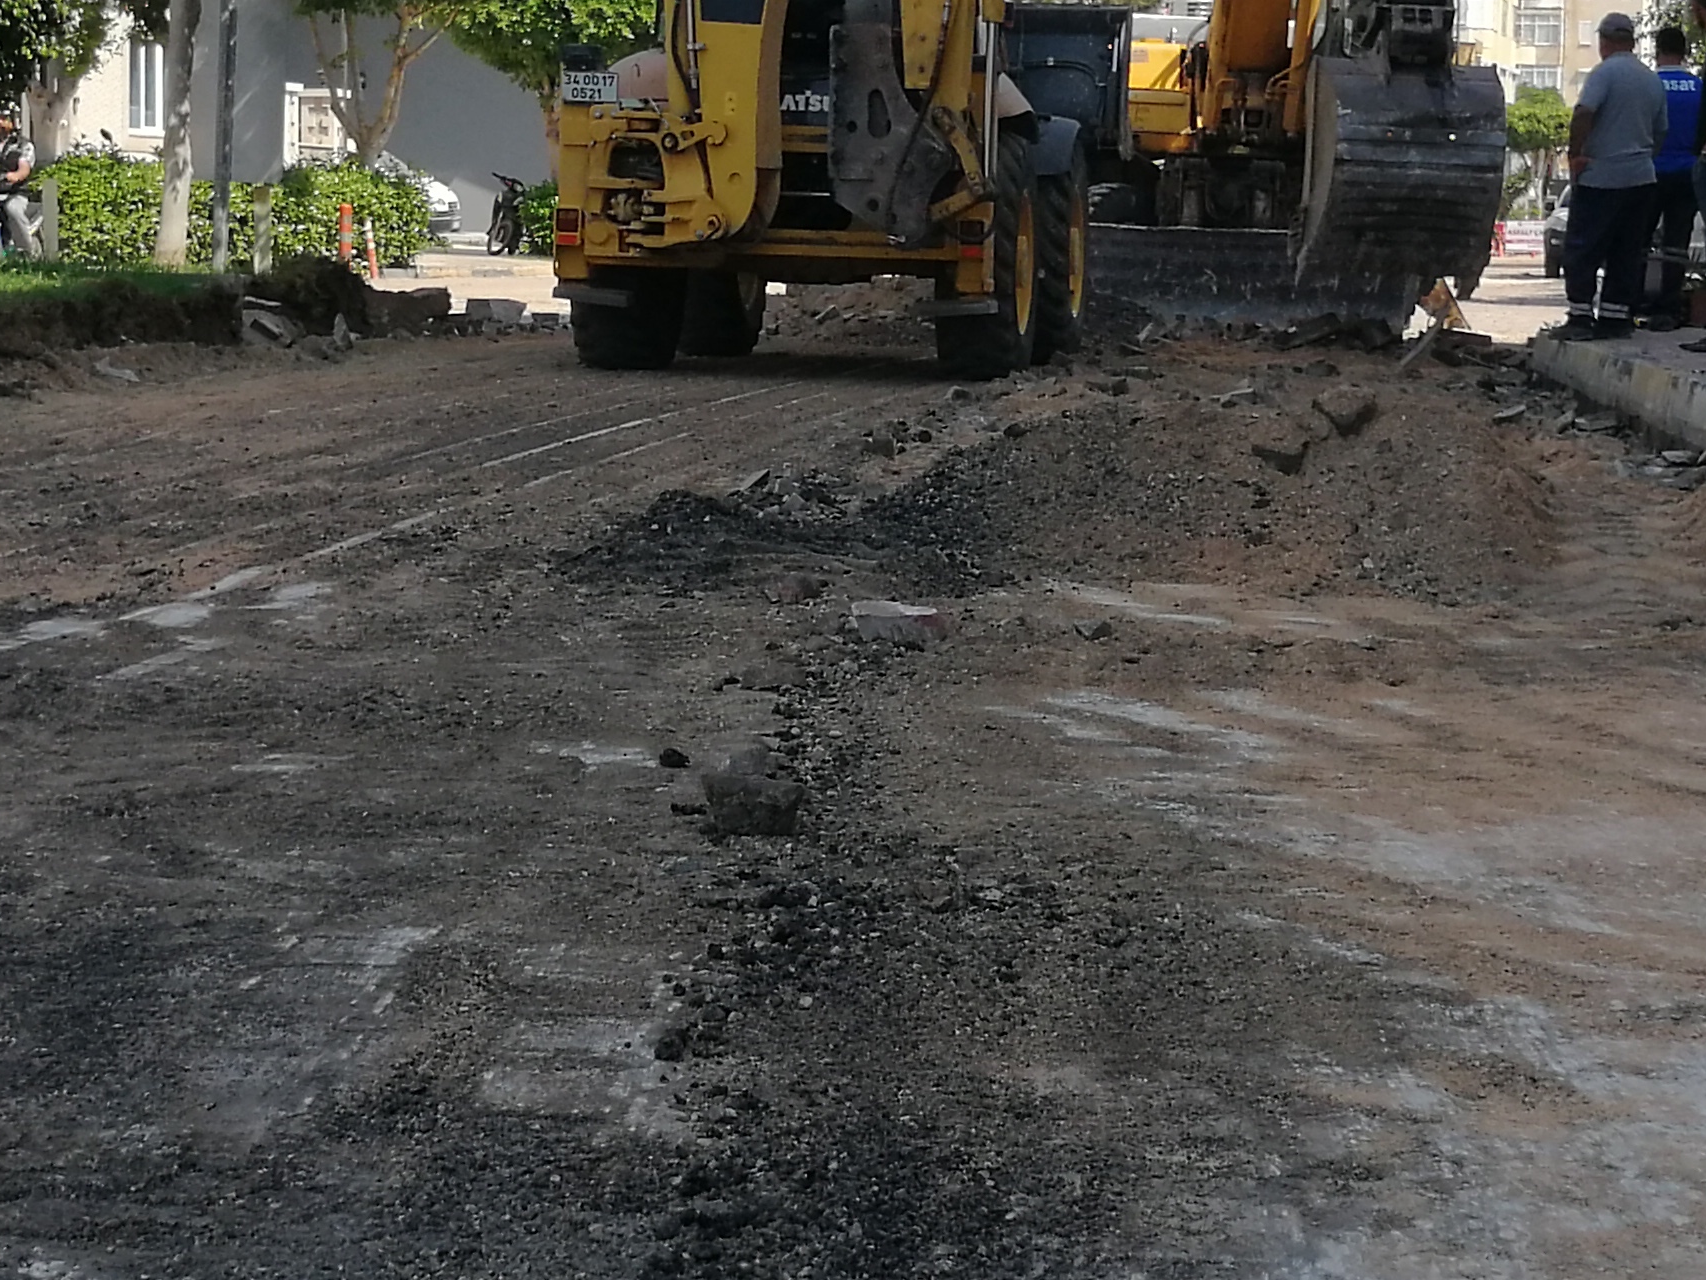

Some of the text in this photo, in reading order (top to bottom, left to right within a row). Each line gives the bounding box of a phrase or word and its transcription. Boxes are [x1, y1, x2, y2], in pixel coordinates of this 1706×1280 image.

[564, 74, 615, 87] 34 00 17
[571, 87, 602, 99] 0521
